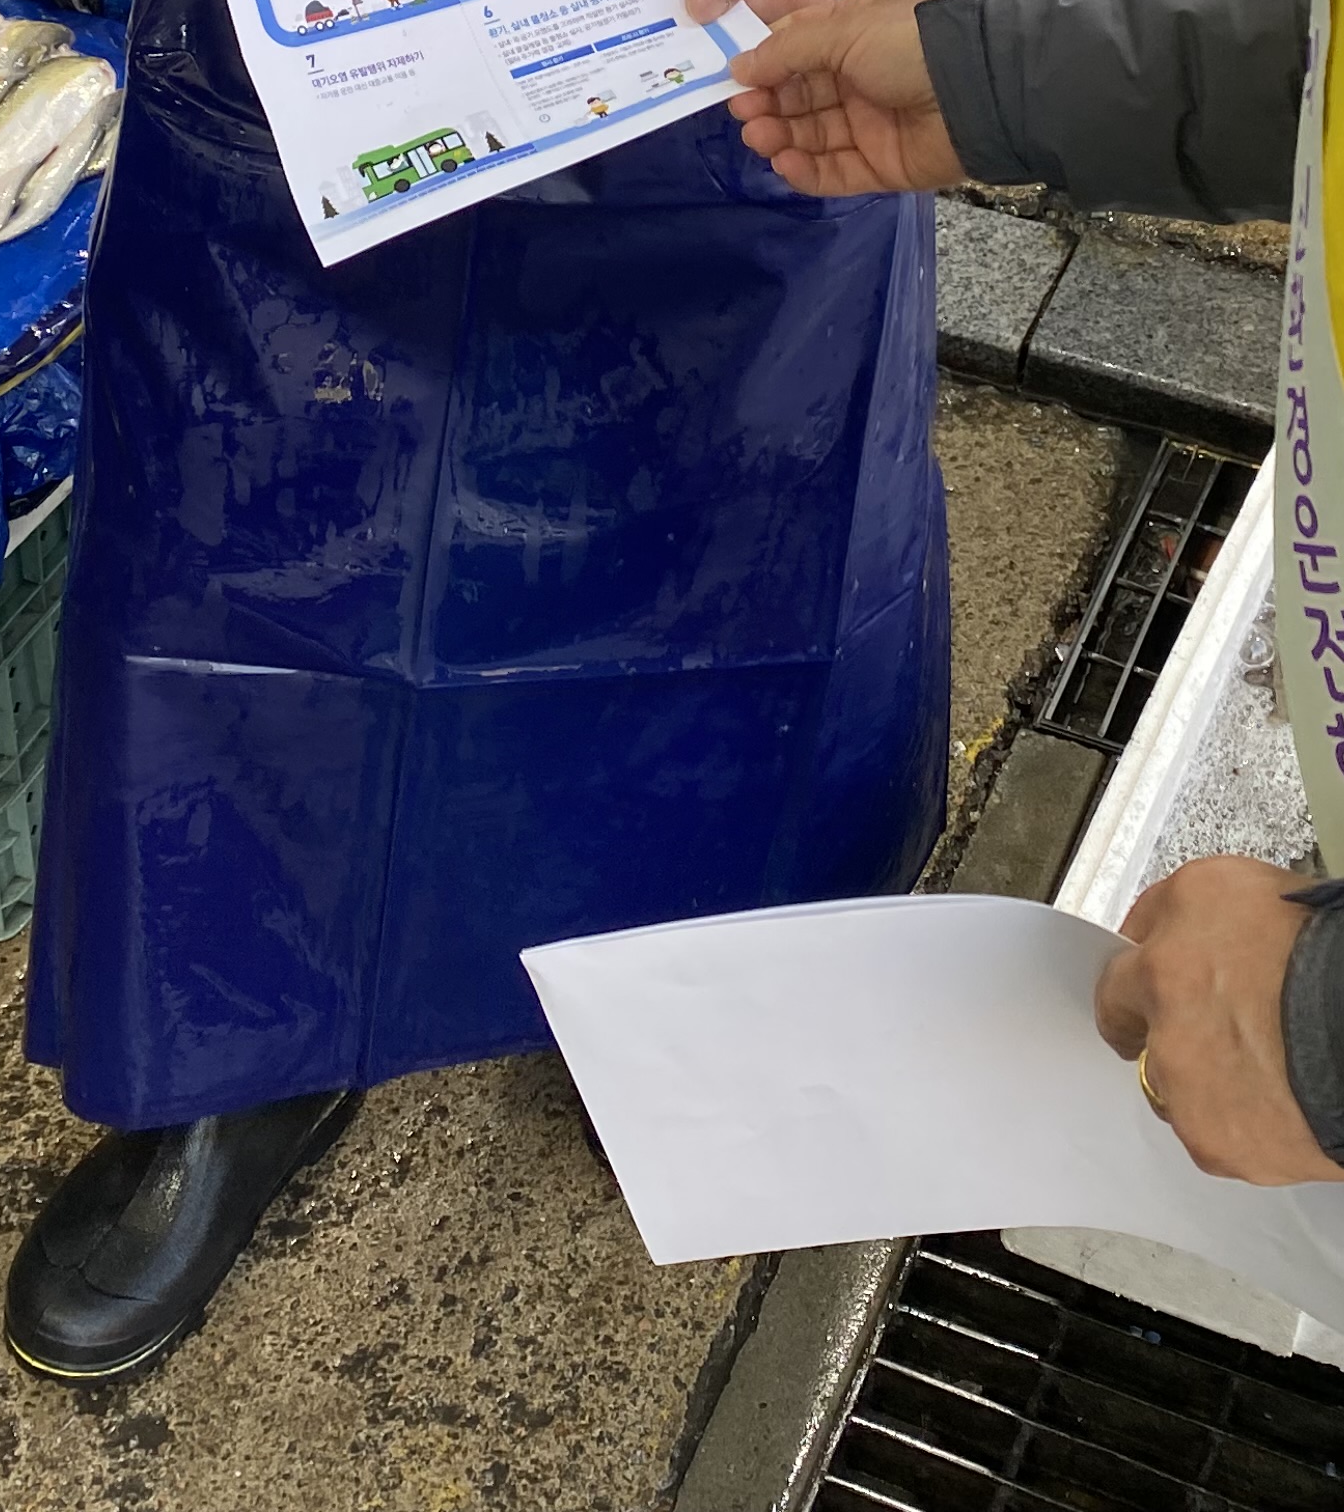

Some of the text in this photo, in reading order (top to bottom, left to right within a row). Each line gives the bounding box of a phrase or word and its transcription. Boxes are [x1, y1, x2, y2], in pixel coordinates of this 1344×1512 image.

[484, 5, 493, 19] 6
[511, 16, 530, 32] 실내
[306, 54, 315, 68] 7
[312, 50, 425, 88] 대기오염 유발행위 자제하기
